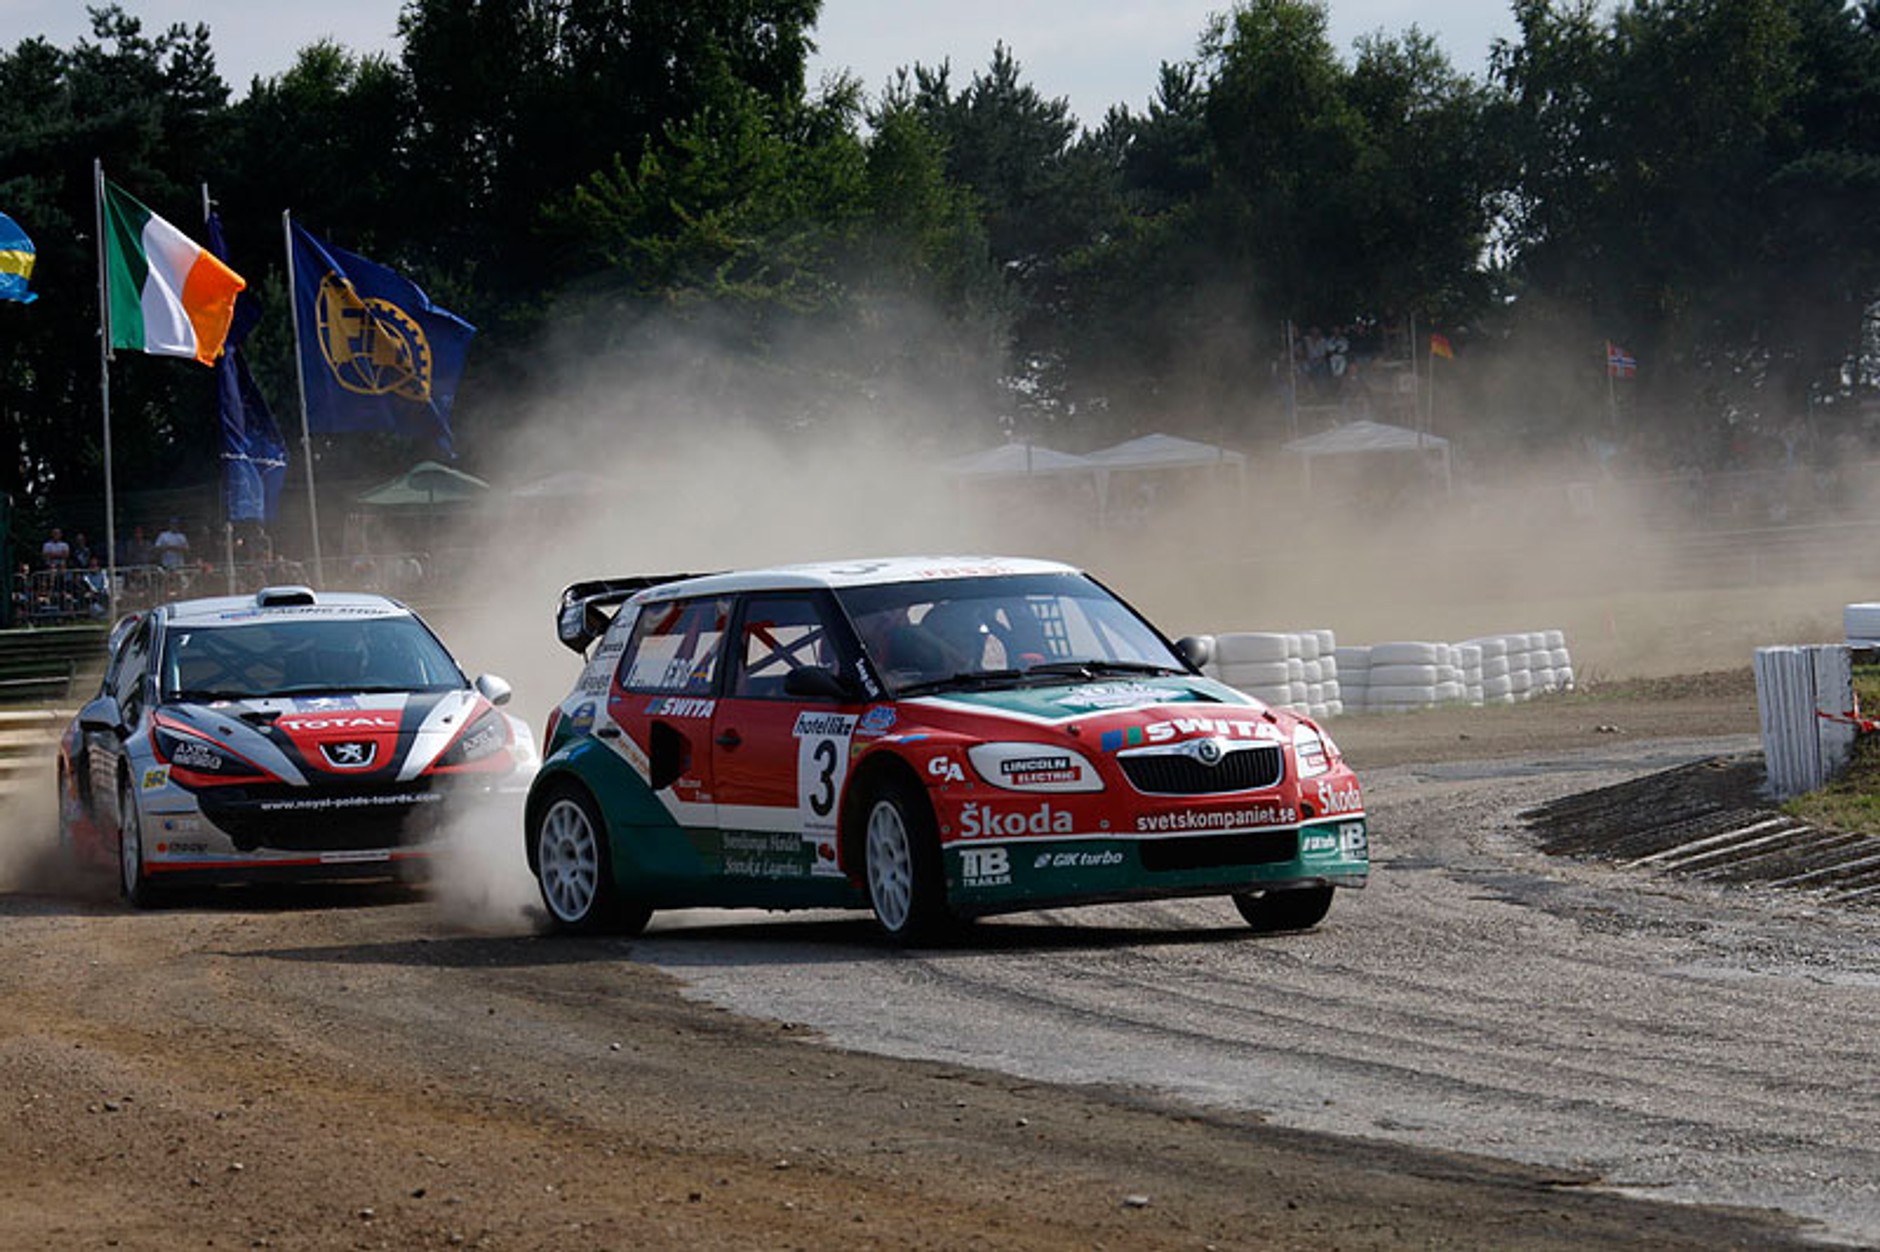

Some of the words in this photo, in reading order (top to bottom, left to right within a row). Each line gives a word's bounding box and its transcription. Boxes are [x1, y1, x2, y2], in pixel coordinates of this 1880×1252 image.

[659, 697, 716, 719] SWITA
[282, 716, 397, 731] TOTAL
[1145, 718, 1287, 743] SWITA
[927, 756, 966, 782] GA
[1003, 757, 1068, 773] LINCOLN
[1017, 770, 1076, 784] ELECTRIC
[807, 739, 838, 817] 3
[1317, 779, 1363, 815] Škoda
[959, 802, 1074, 838] Škoda
[1136, 804, 1297, 832] svetskompaniet.se
[958, 847, 1011, 877] TB
[1080, 850, 1124, 866] turbo
[962, 875, 1013, 888] TRAILER
